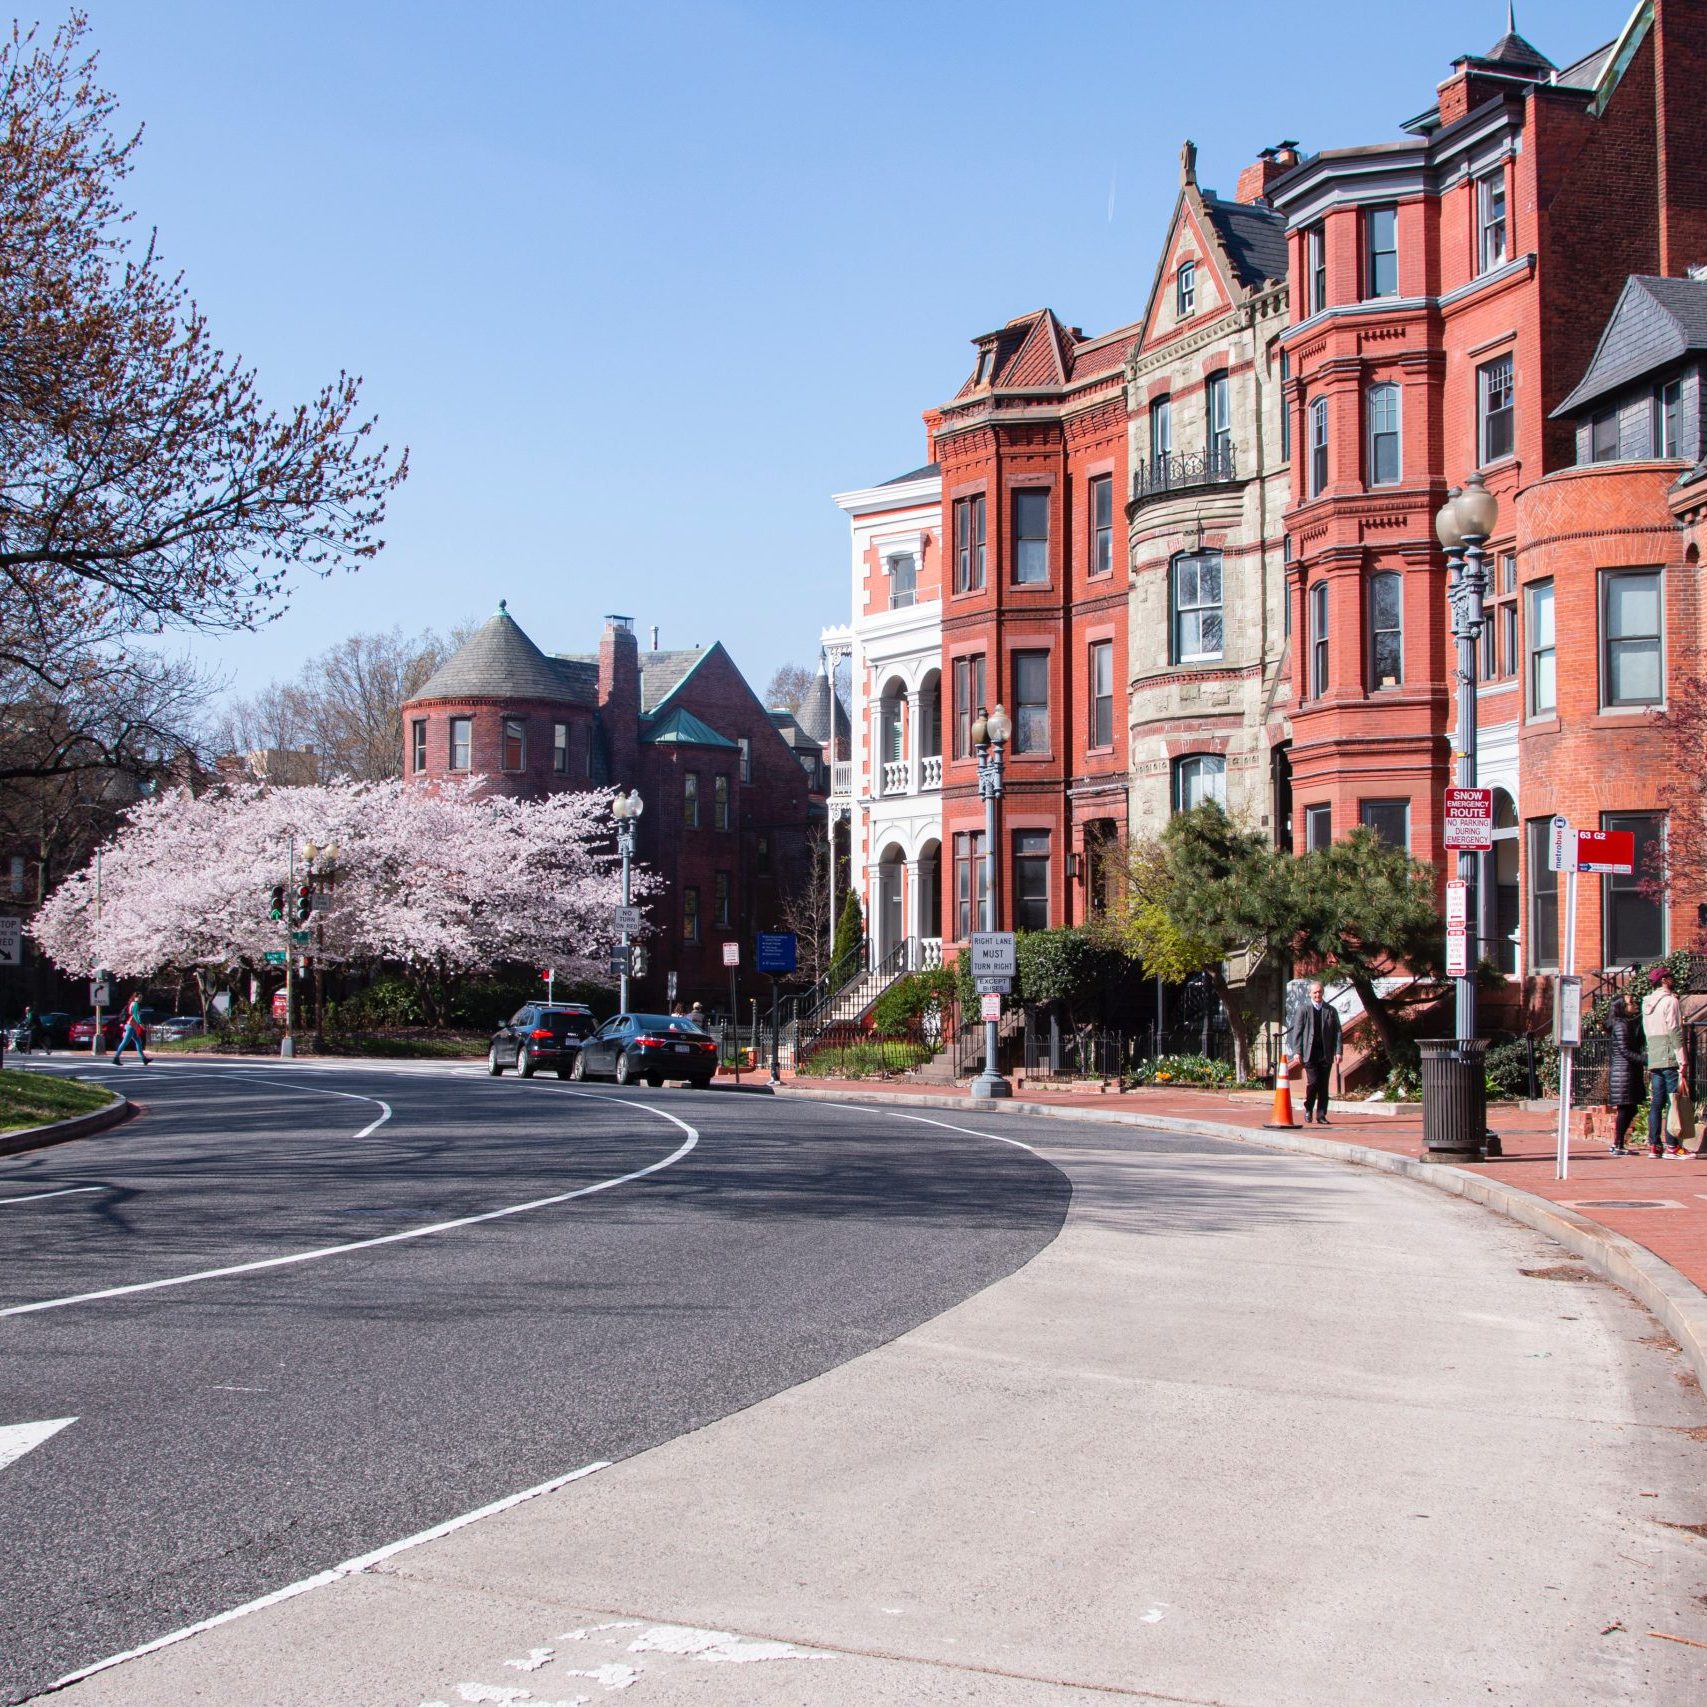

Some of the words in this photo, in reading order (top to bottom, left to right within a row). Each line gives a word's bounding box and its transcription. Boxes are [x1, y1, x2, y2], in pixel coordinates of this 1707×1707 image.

[1453, 791, 1483, 800] SNOW
[1450, 808, 1486, 817] ROUTE
[1461, 819, 1489, 827] PARKING
[1579, 831, 1591, 839] 63
[1594, 832, 1606, 840] G2
[1447, 836, 1489, 844] EMERGENCY
[983, 950, 1004, 958] MUST
